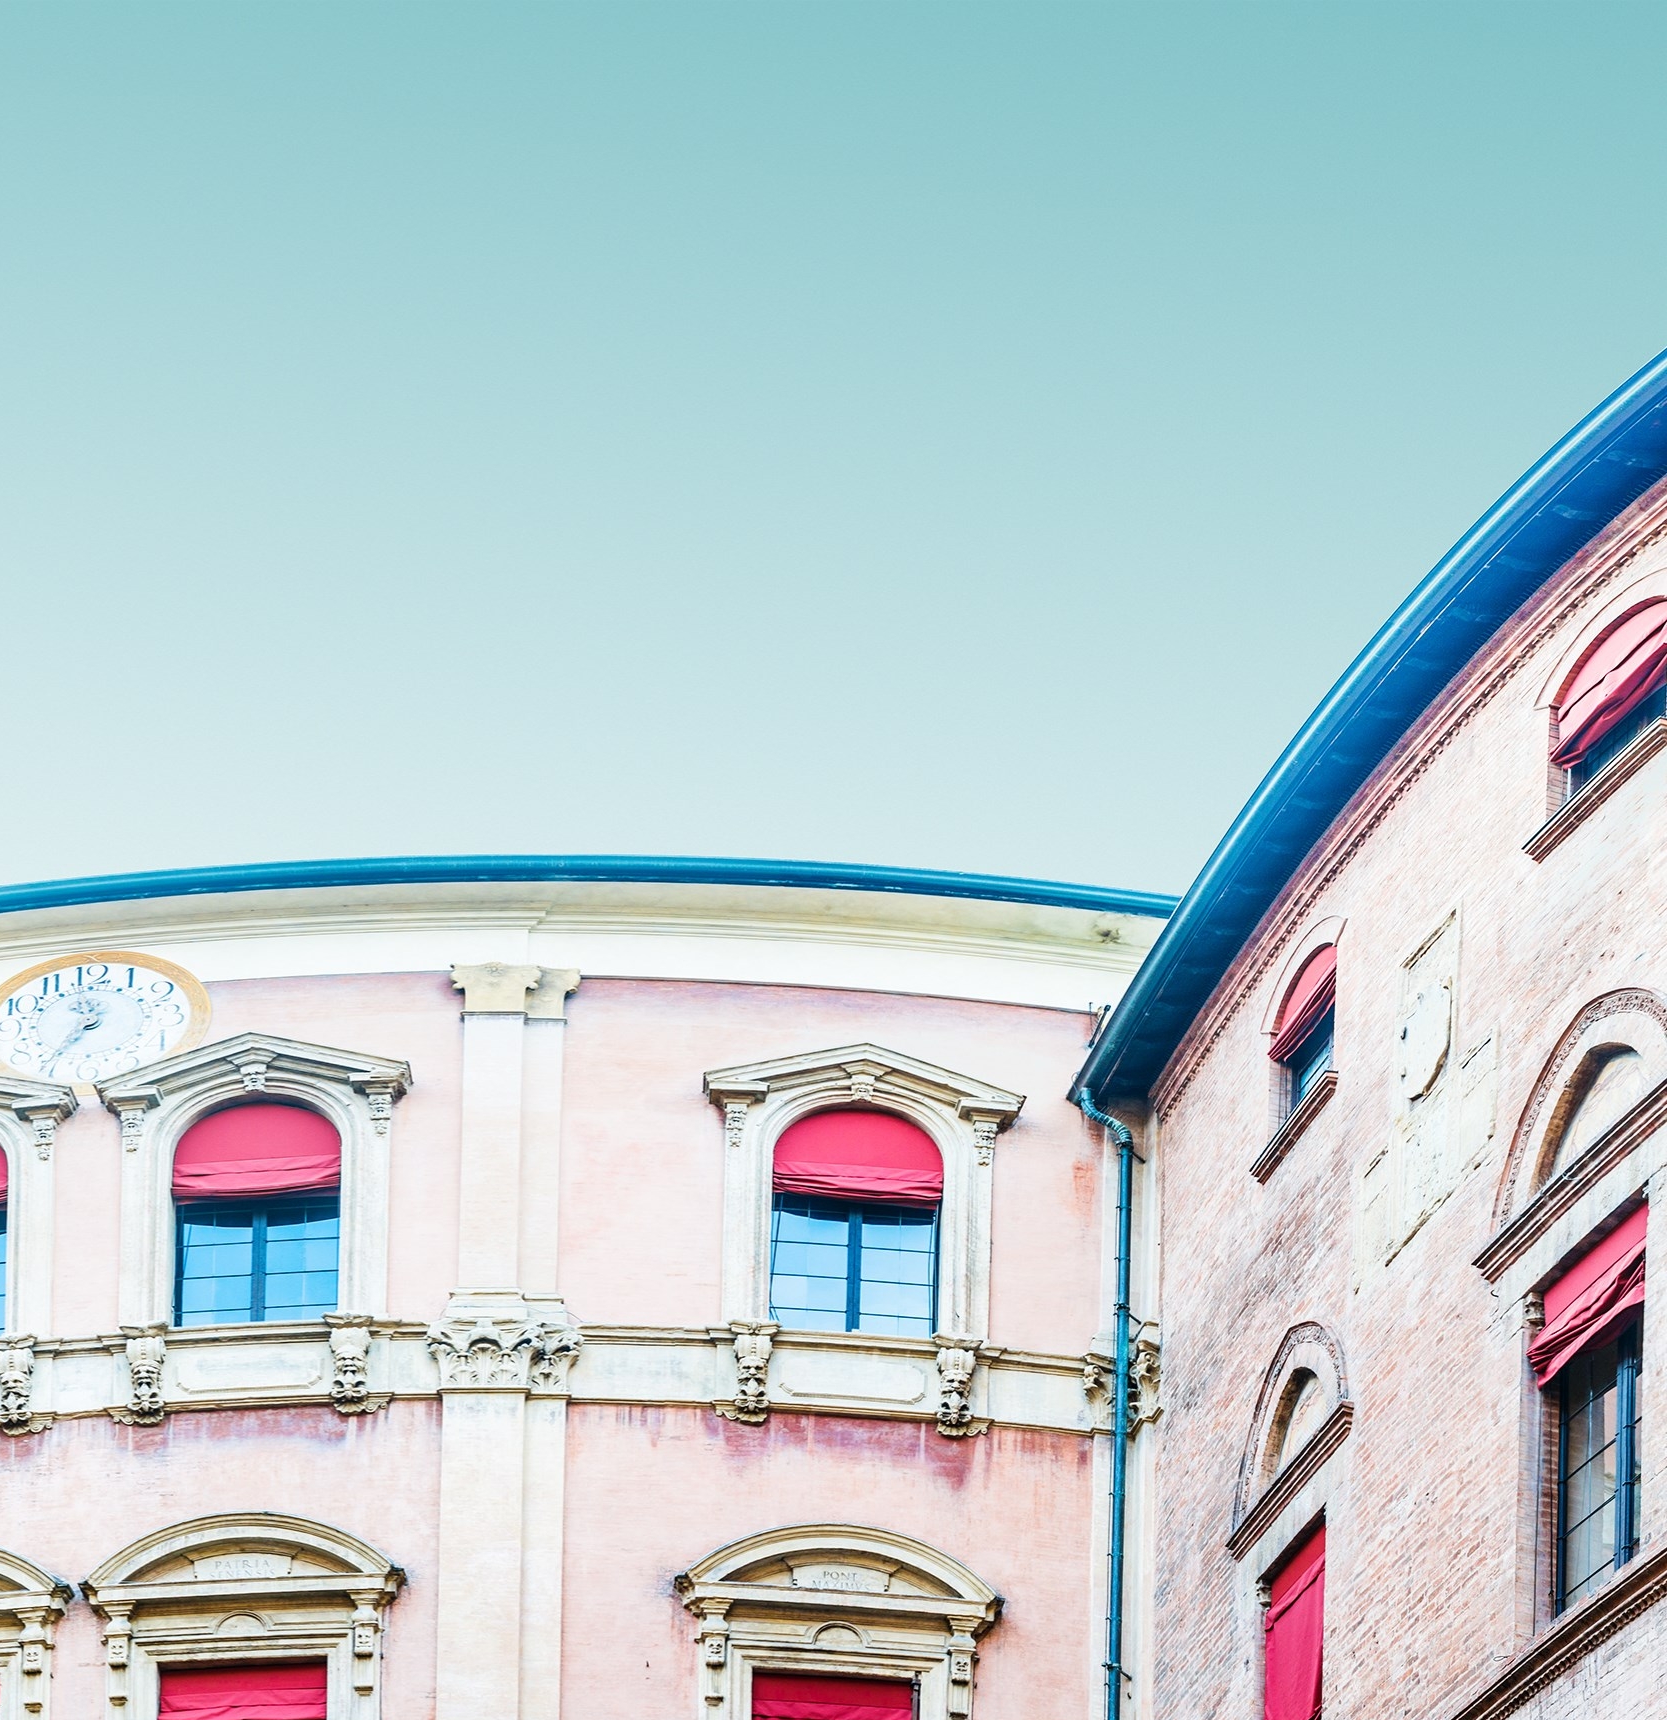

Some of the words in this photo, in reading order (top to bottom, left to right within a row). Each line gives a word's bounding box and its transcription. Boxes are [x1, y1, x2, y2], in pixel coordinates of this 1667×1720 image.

[42, 973, 61, 996] 11
[76, 964, 110, 986] 12
[125, 967, 135, 989] 1
[151, 981, 175, 1004] 2
[7, 994, 39, 1016] 10
[158, 1003, 185, 1027] 3
[145, 1029, 166, 1052] 4
[10, 1043, 32, 1065] 8
[115, 1050, 139, 1072] 5
[75, 1059, 99, 1082] 6
